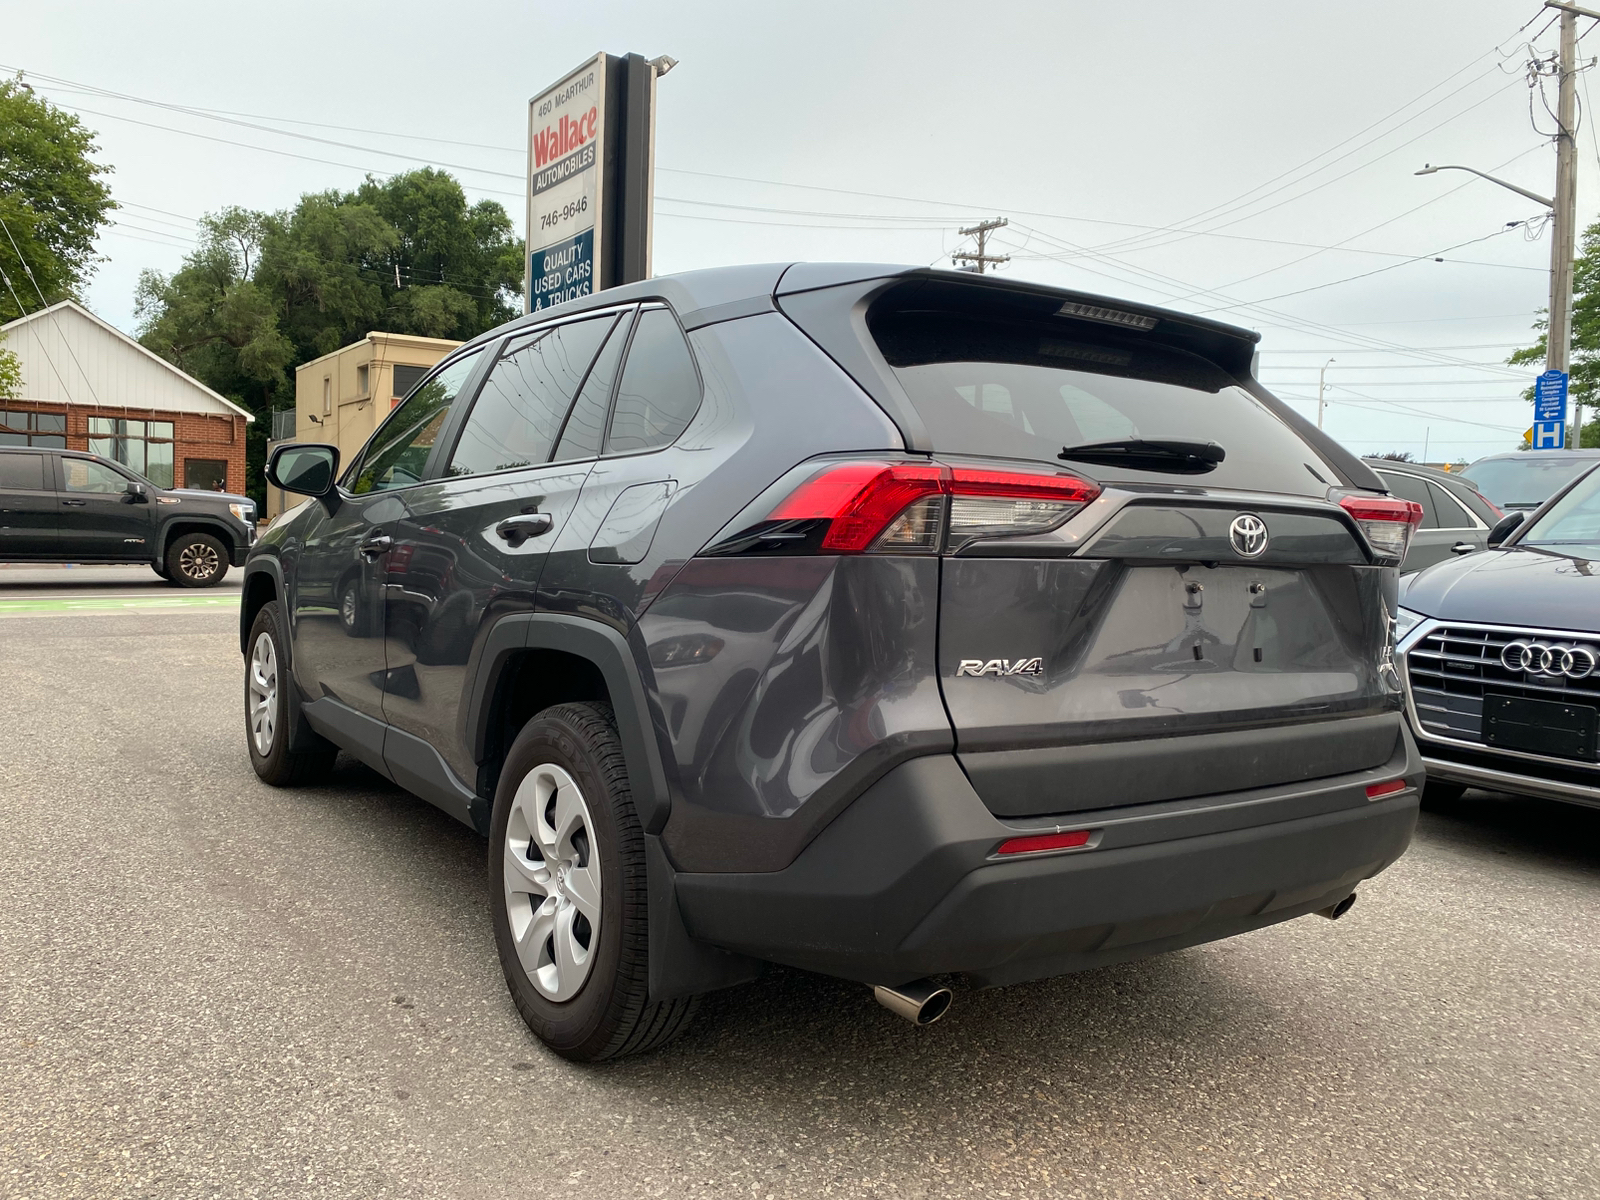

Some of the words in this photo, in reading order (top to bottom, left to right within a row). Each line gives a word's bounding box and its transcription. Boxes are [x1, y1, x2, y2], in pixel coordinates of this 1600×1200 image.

[538, 100, 552, 117] 460
[555, 72, 594, 108] McARTHUR
[533, 106, 597, 168] Wallace
[536, 146, 594, 191] AUTOMOBILES
[541, 196, 588, 230] 746-9646
[543, 242, 584, 272] QUALITY
[534, 273, 562, 295] USED
[565, 260, 591, 284] CARS
[535, 297, 543, 312] &
[548, 281, 590, 307] TRUCKS
[1537, 423, 1560, 448] H
[956, 657, 1043, 677] RAV4
[545, 729, 600, 806] TOYO
